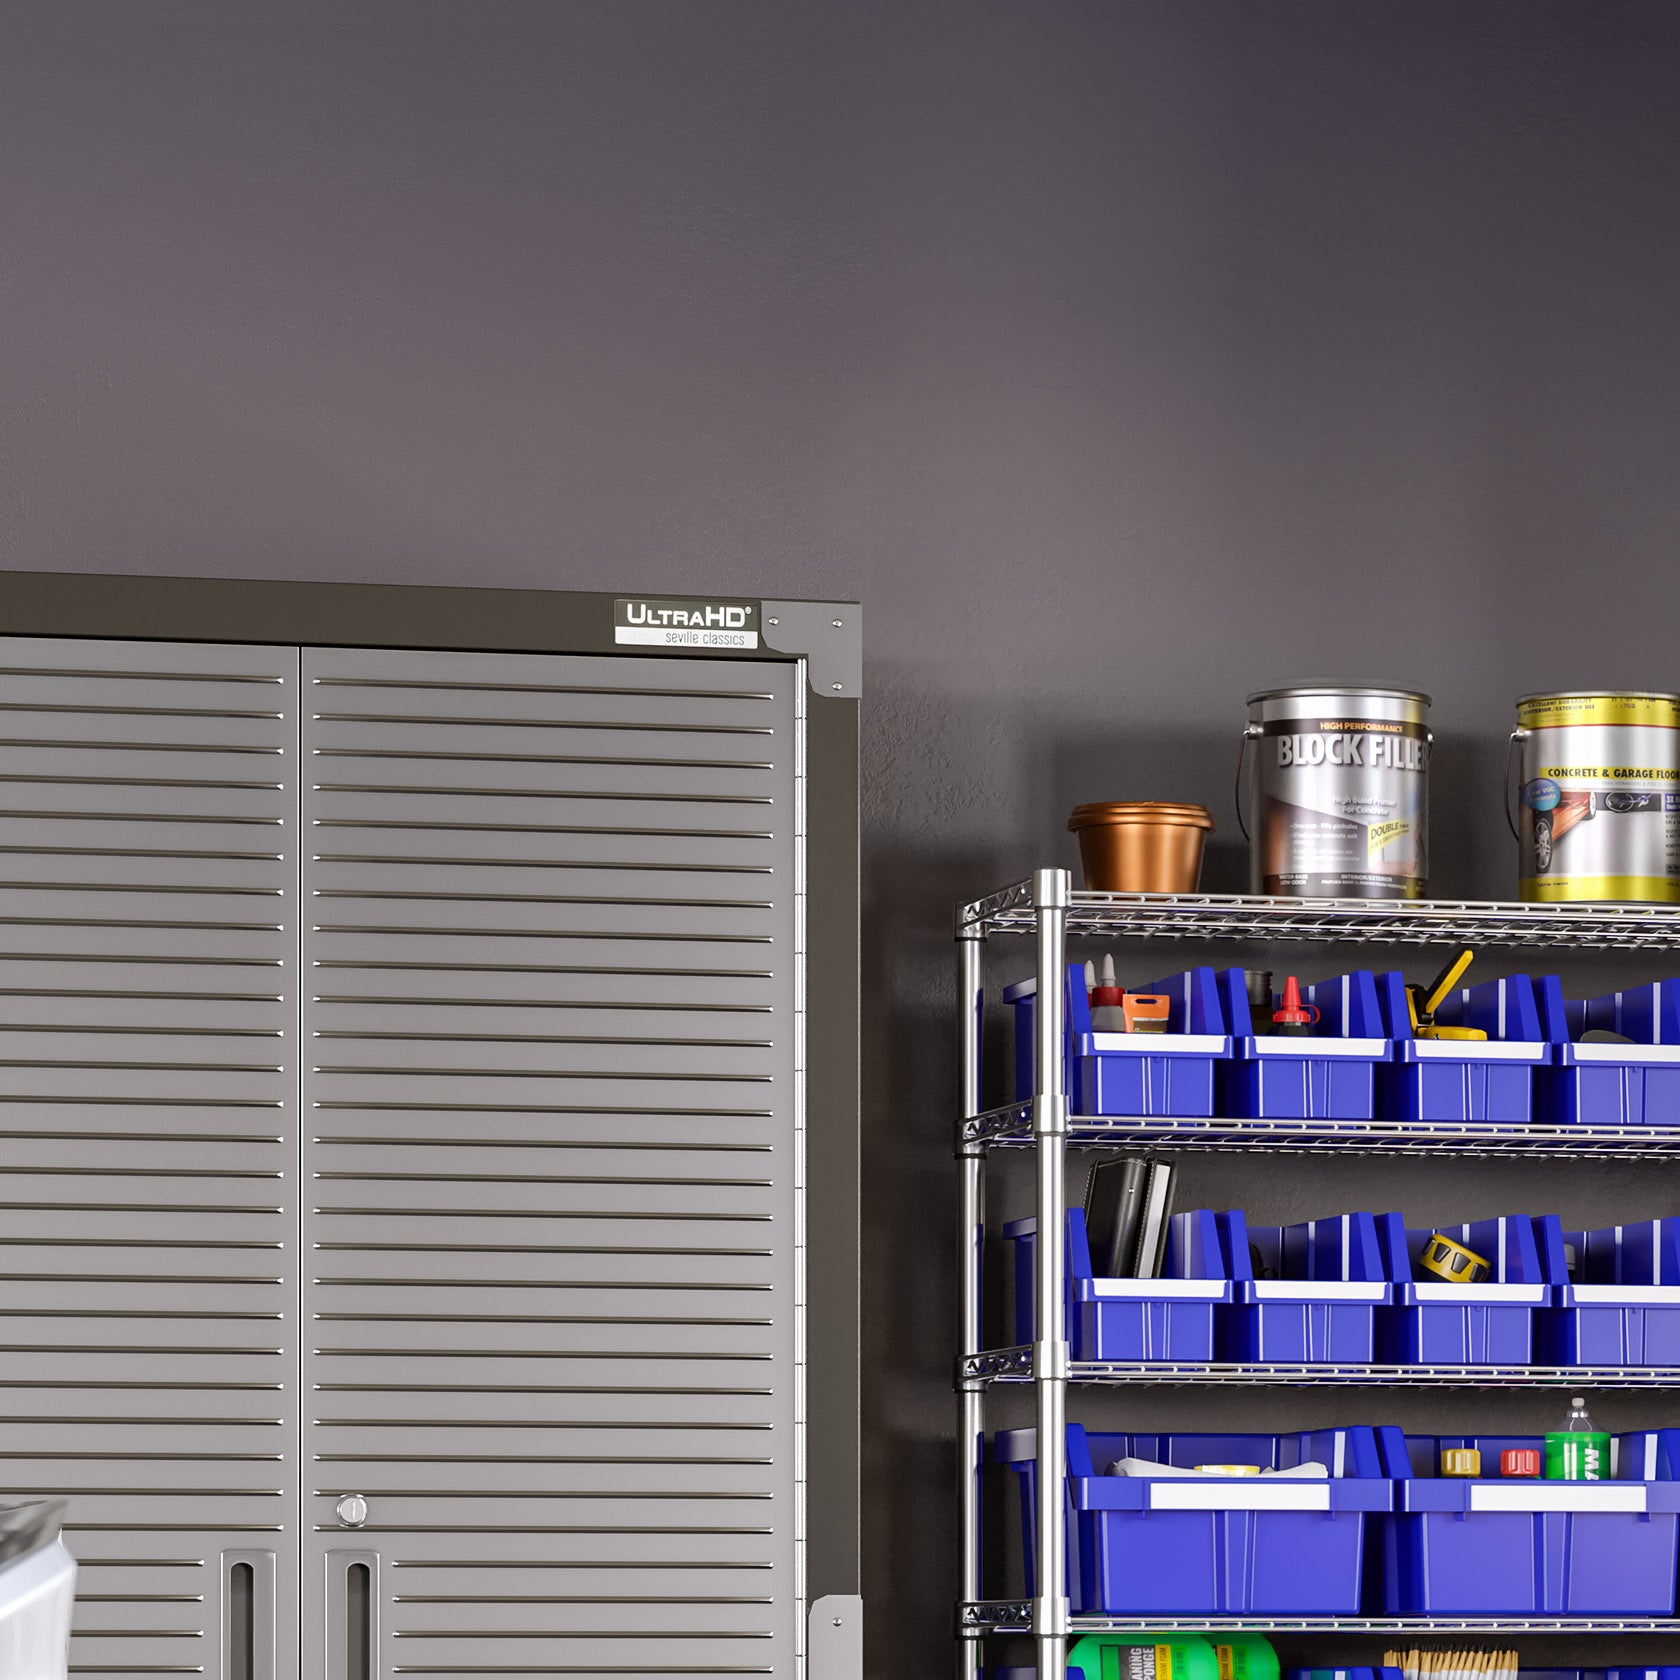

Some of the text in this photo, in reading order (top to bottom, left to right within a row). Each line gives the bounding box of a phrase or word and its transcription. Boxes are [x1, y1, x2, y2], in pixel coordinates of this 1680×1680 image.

[665, 631, 745, 646] seville classics
[1320, 721, 1404, 734] HIGH PERFORMANCE
[1279, 734, 1363, 766] BLOCK
[1548, 768, 1598, 778] CONCRETE
[1602, 768, 1610, 778] &
[1614, 768, 1655, 779] GARAGE
[1656, 770, 1680, 781] FLOOR
[1371, 822, 1399, 840] DOUBLE
[1158, 1647, 1168, 1662] FOAM
[1219, 1647, 1230, 1662] FOAM
